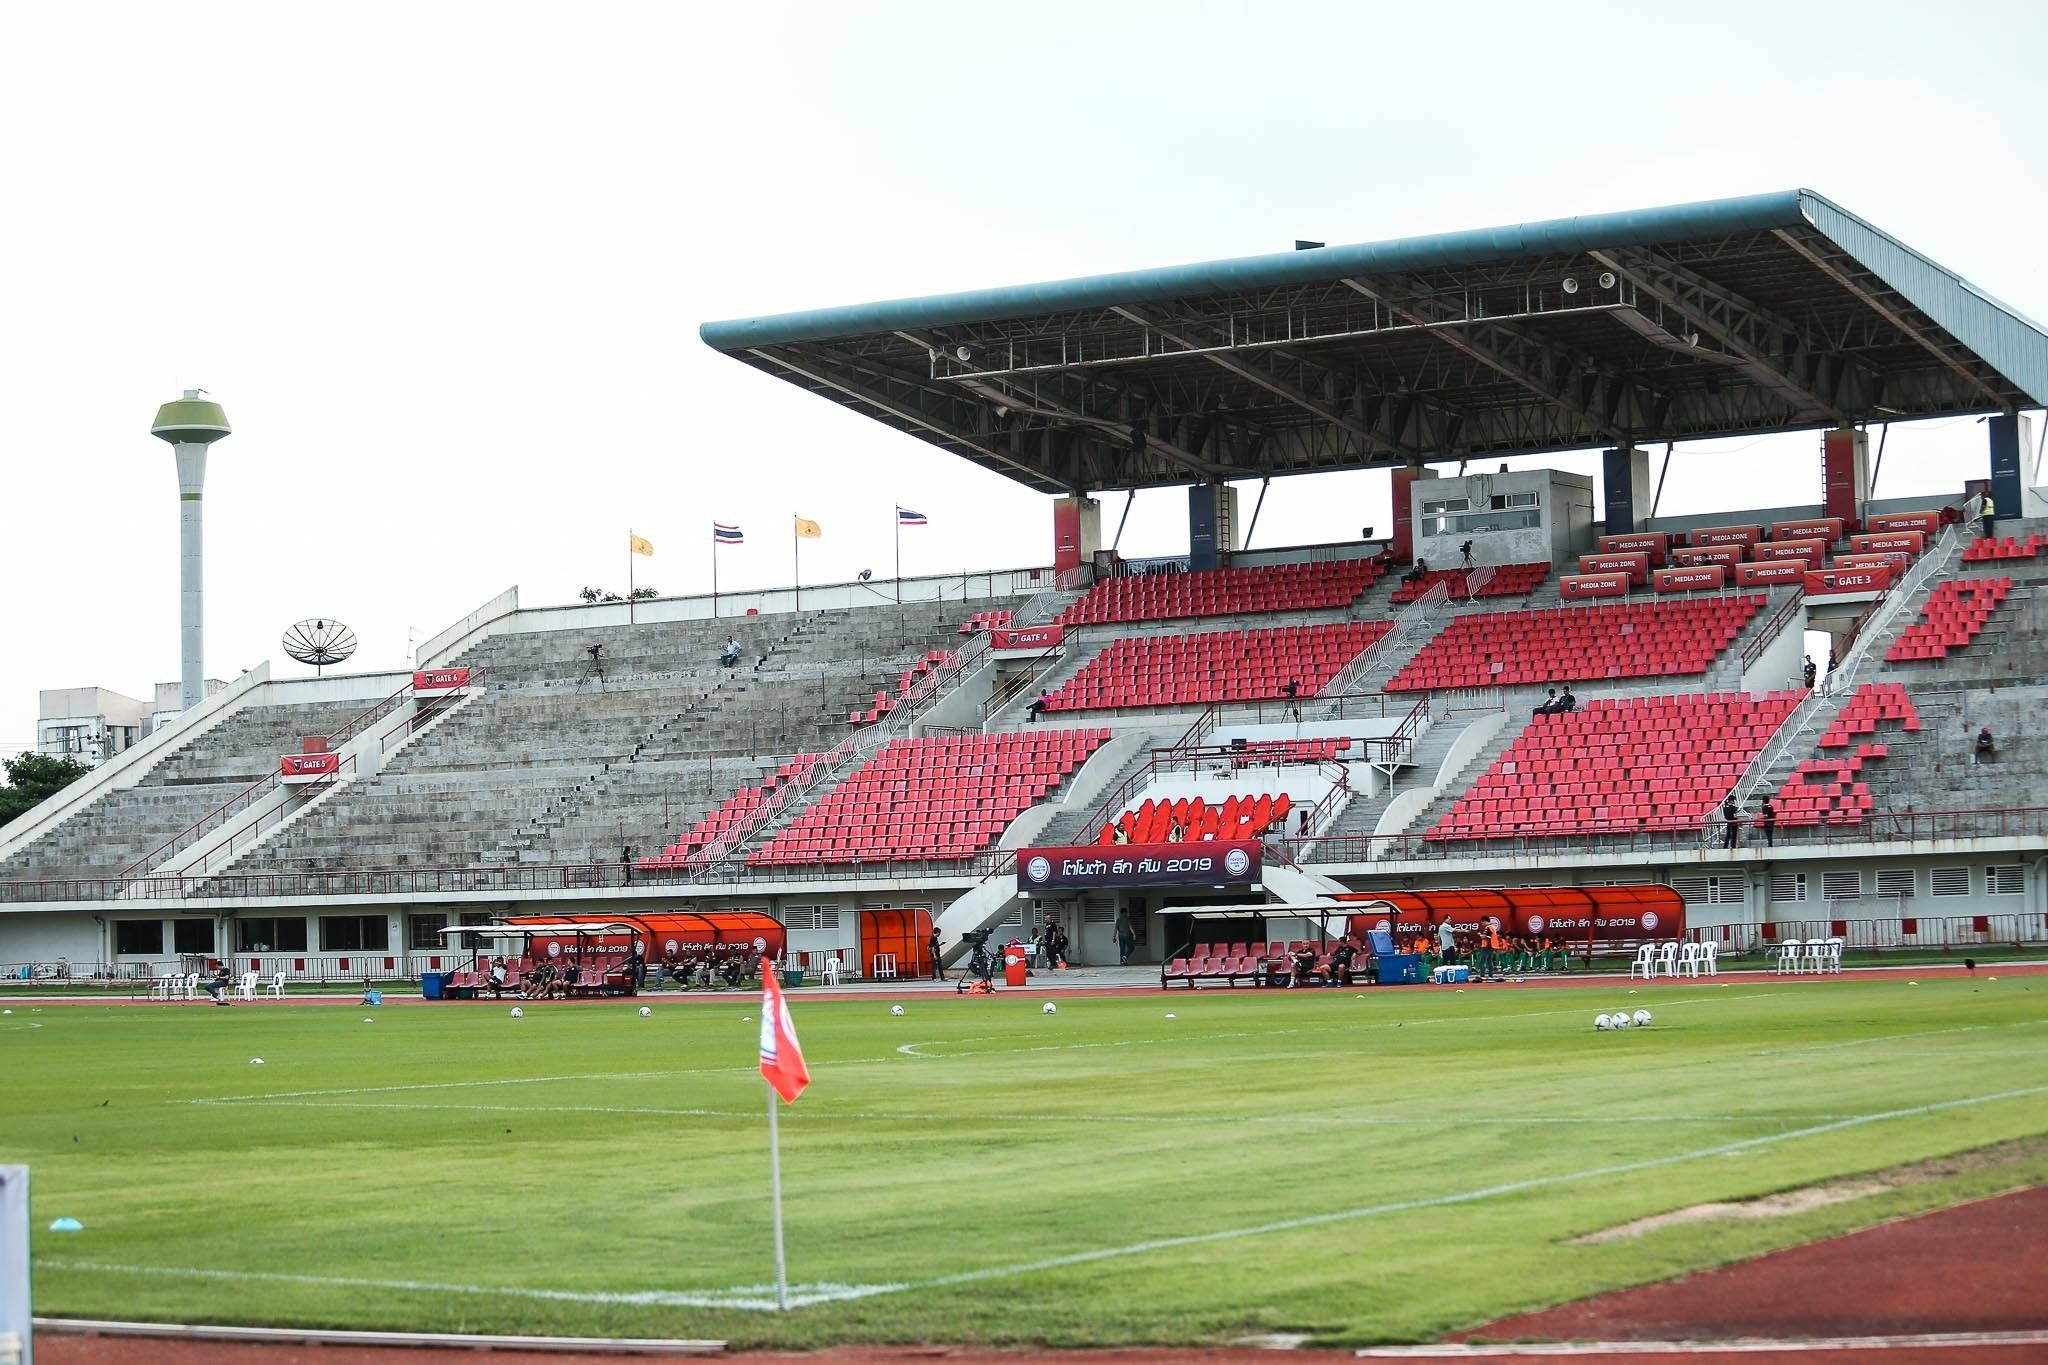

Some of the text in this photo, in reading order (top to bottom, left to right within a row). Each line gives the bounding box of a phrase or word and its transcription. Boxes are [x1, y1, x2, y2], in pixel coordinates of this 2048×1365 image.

[1909, 519, 1928, 527] ZONE
[1813, 526, 1830, 534] ZONE
[1619, 540, 1655, 549] MEDIA ZONE
[1893, 539, 1911, 547] ZONE
[1775, 546, 1813, 556] MEDIA ZONE
[1713, 553, 1730, 561] ZONE
[1600, 560, 1636, 569] MEDIA ZONE
[1757, 567, 1795, 577] MEDIA ZONE
[1694, 574, 1712, 582] ZONE
[1839, 575, 1872, 586] GATE 3
[1600, 581, 1617, 589] ZONE
[1020, 633, 1041, 642] GATE
[435, 674, 452, 683] GATE
[303, 760, 326, 769] GATE 5
[1062, 859, 1107, 876] โตโยต้า
[1112, 858, 1133, 874] ลีก
[1137, 858, 1161, 873] คัพ
[1166, 857, 1212, 872] 2019
[1396, 922, 1422, 932] โตโยต้า
[1454, 922, 1479, 931] 2019
[1549, 918, 1576, 928] โตโยต้า
[1609, 918, 1636, 927] 2019
[608, 944, 628, 953] 2019
